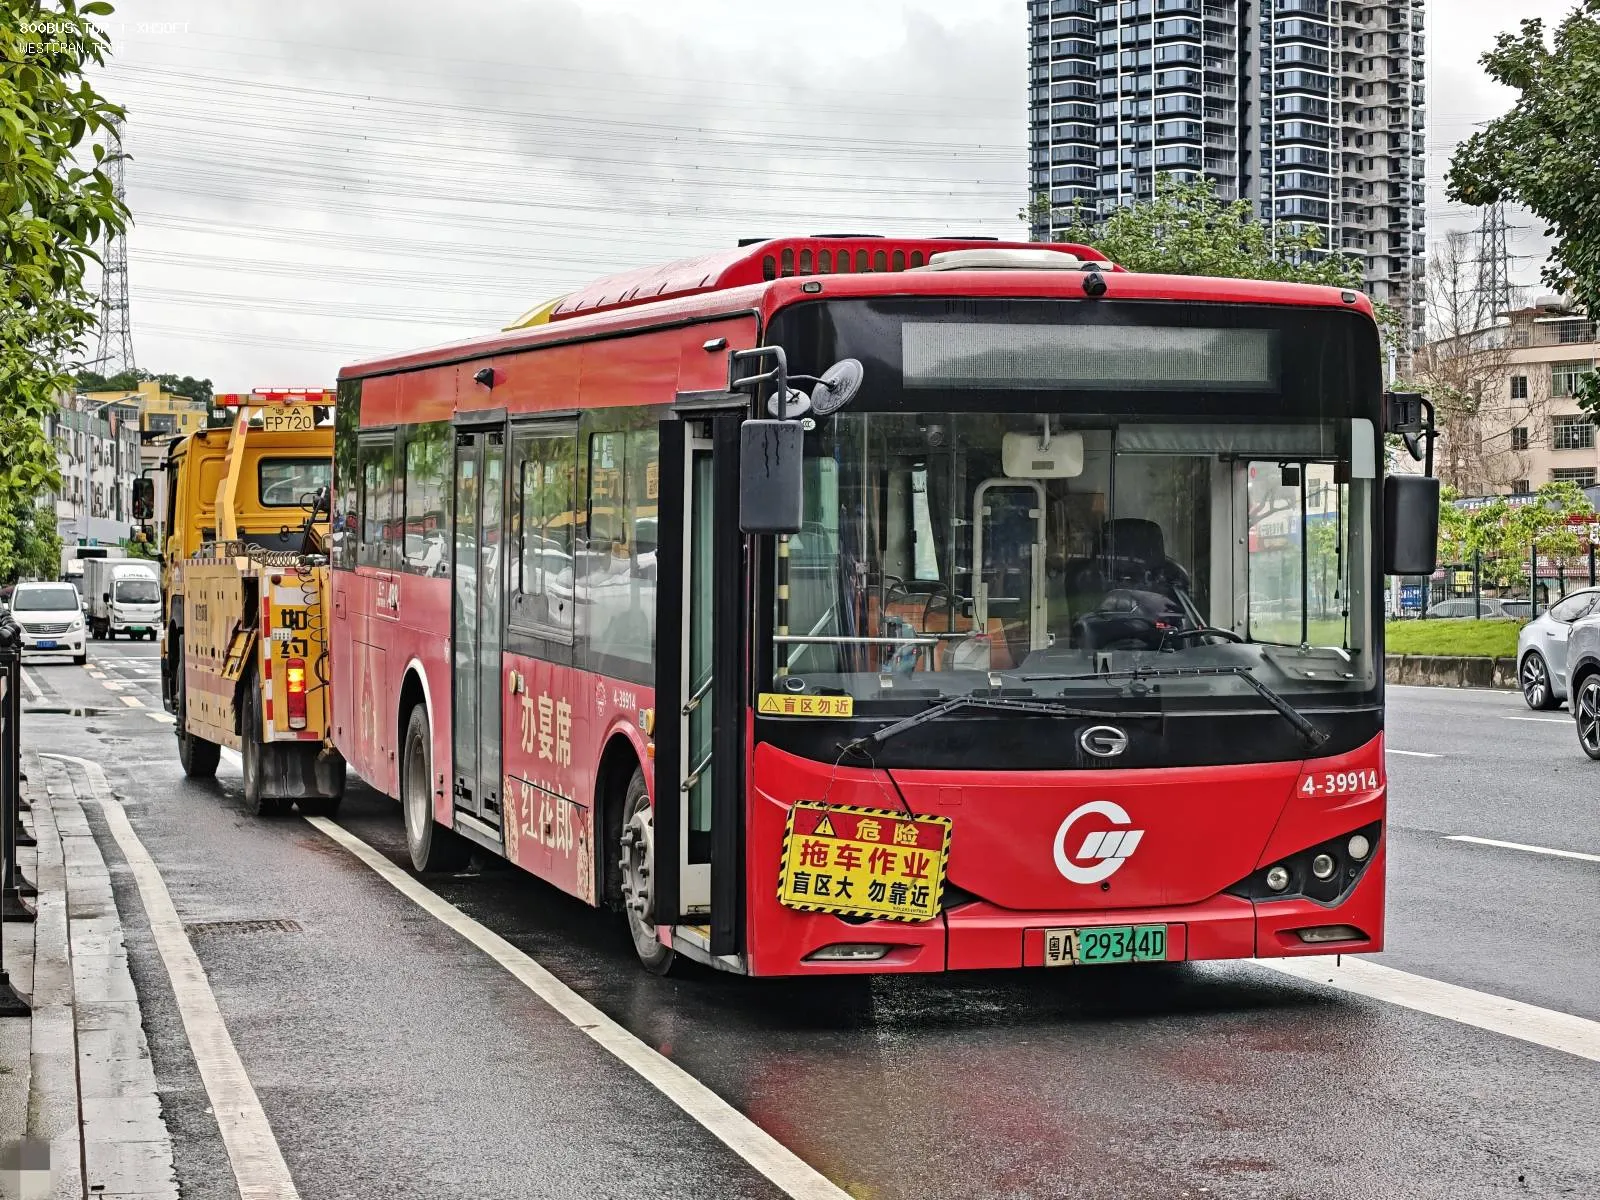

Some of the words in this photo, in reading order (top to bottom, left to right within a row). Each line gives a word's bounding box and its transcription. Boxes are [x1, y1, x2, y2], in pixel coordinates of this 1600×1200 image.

[265, 416, 312, 430] FP720
[613, 689, 637, 710] 4-39914
[783, 697, 849, 715] 盲区勿近
[521, 686, 572, 769] 办宴席
[1302, 770, 1377, 795] 4-39914
[521, 769, 576, 859] 红花郎
[856, 818, 920, 846] 危险
[800, 839, 930, 880] 拖车作业
[793, 870, 854, 899] 盲区大
[868, 879, 930, 908] 勿靠近
